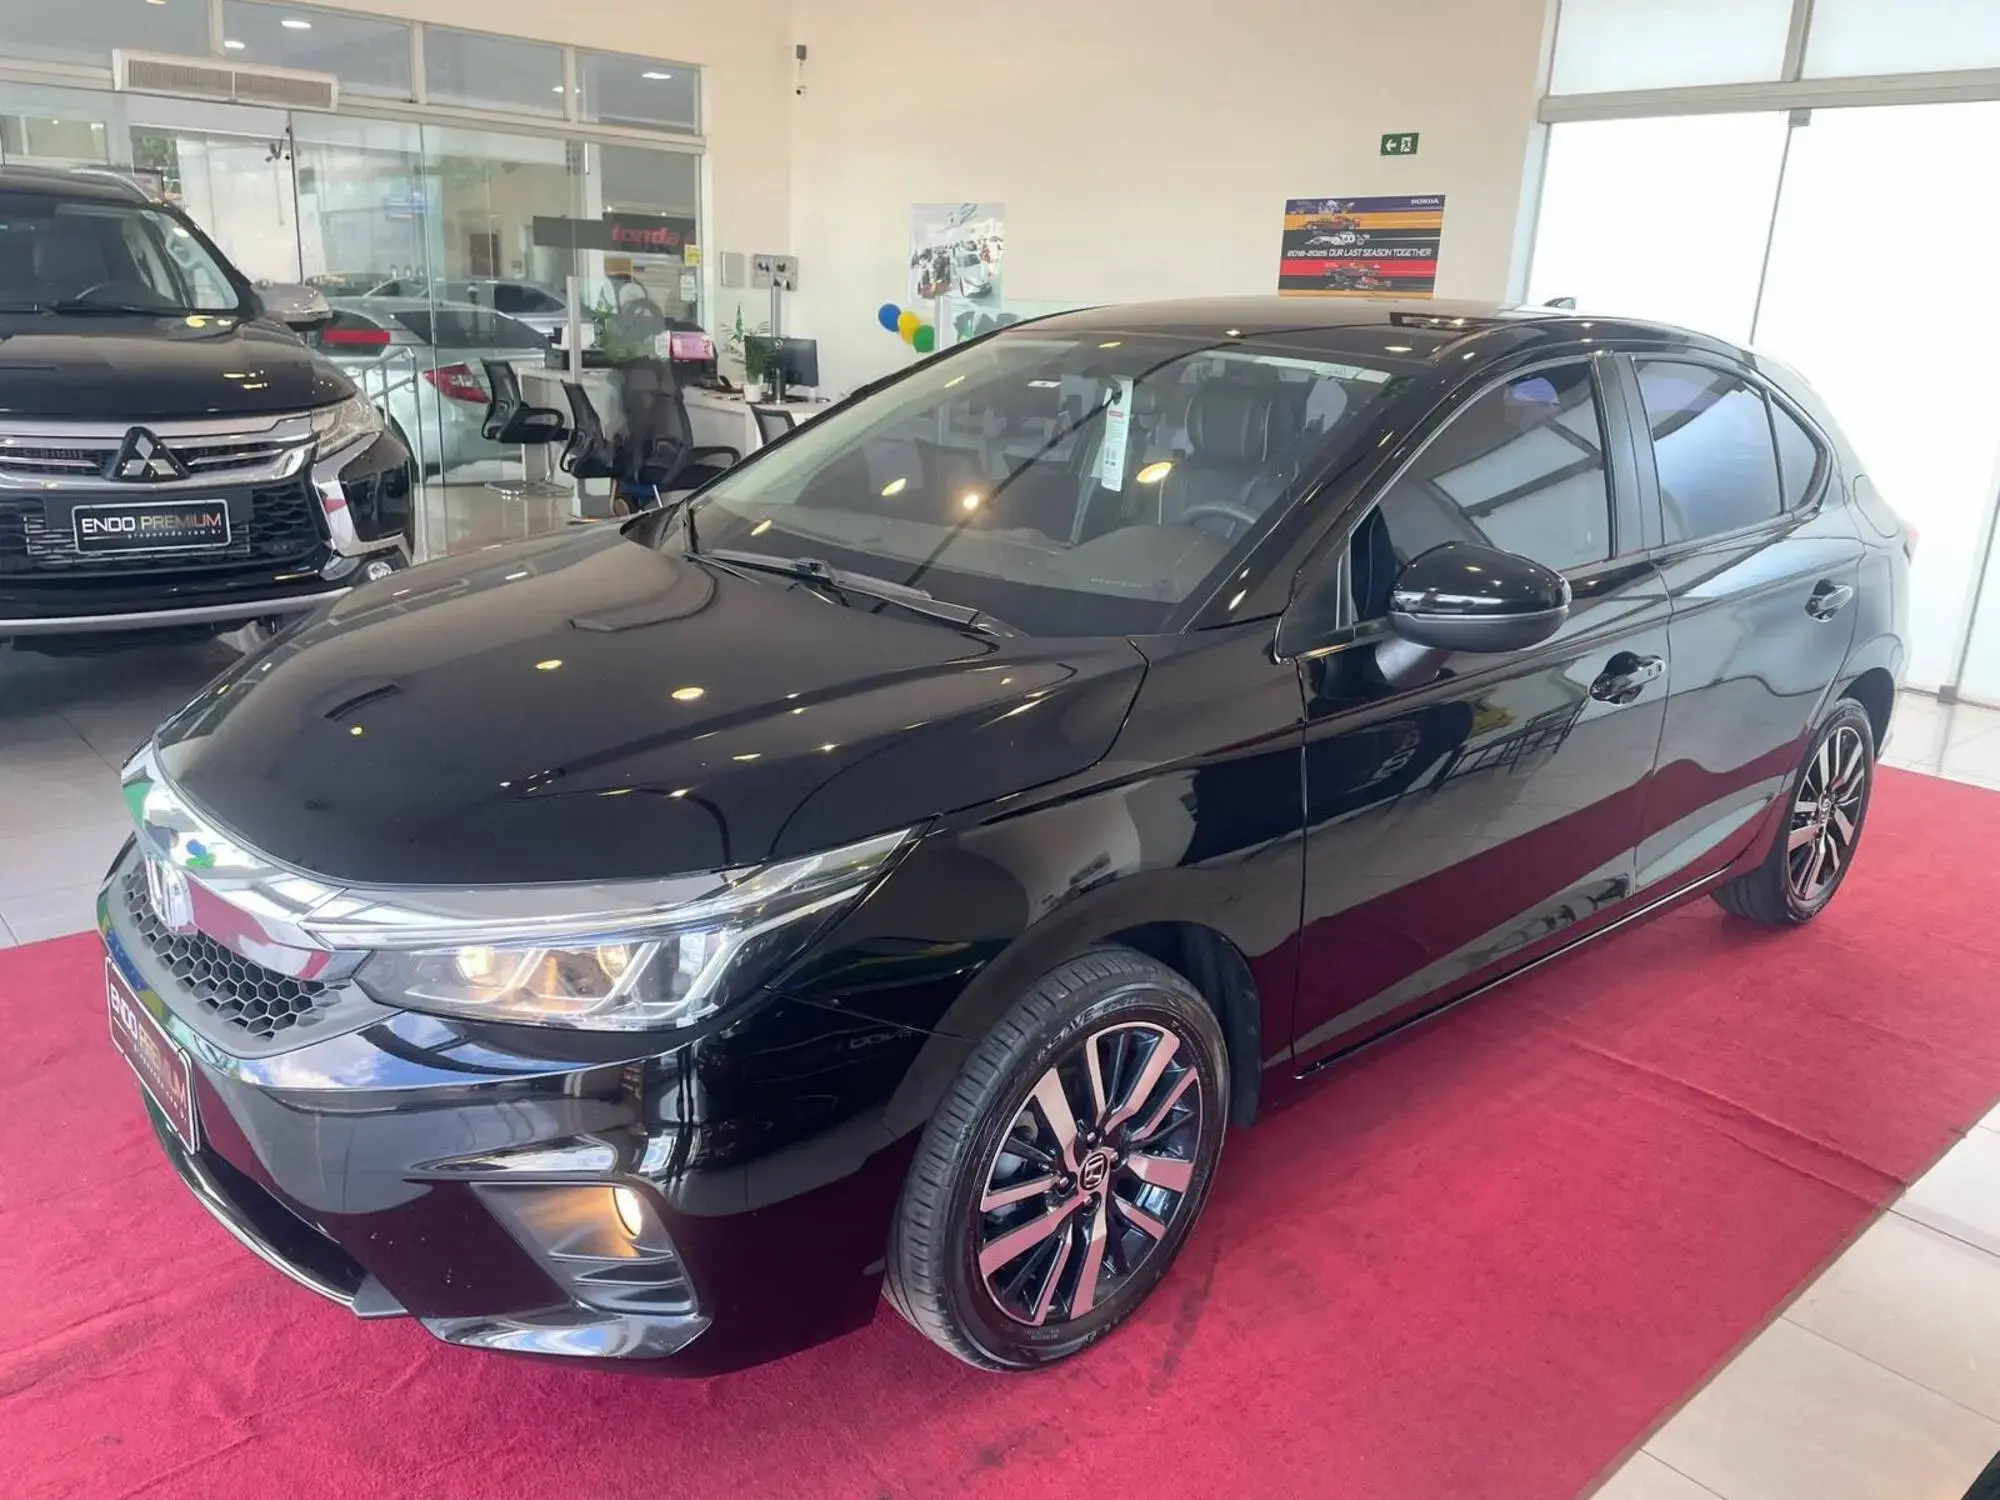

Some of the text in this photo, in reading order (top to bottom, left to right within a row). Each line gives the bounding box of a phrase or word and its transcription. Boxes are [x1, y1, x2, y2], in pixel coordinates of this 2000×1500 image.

[1328, 248, 1344, 257] OUR
[1344, 248, 1363, 257] LAST
[1363, 247, 1392, 257] SEASON
[1393, 247, 1432, 257] TOGETHER
[81, 512, 221, 533] ENDO PREMIUM
[110, 982, 138, 1040] ENDO
